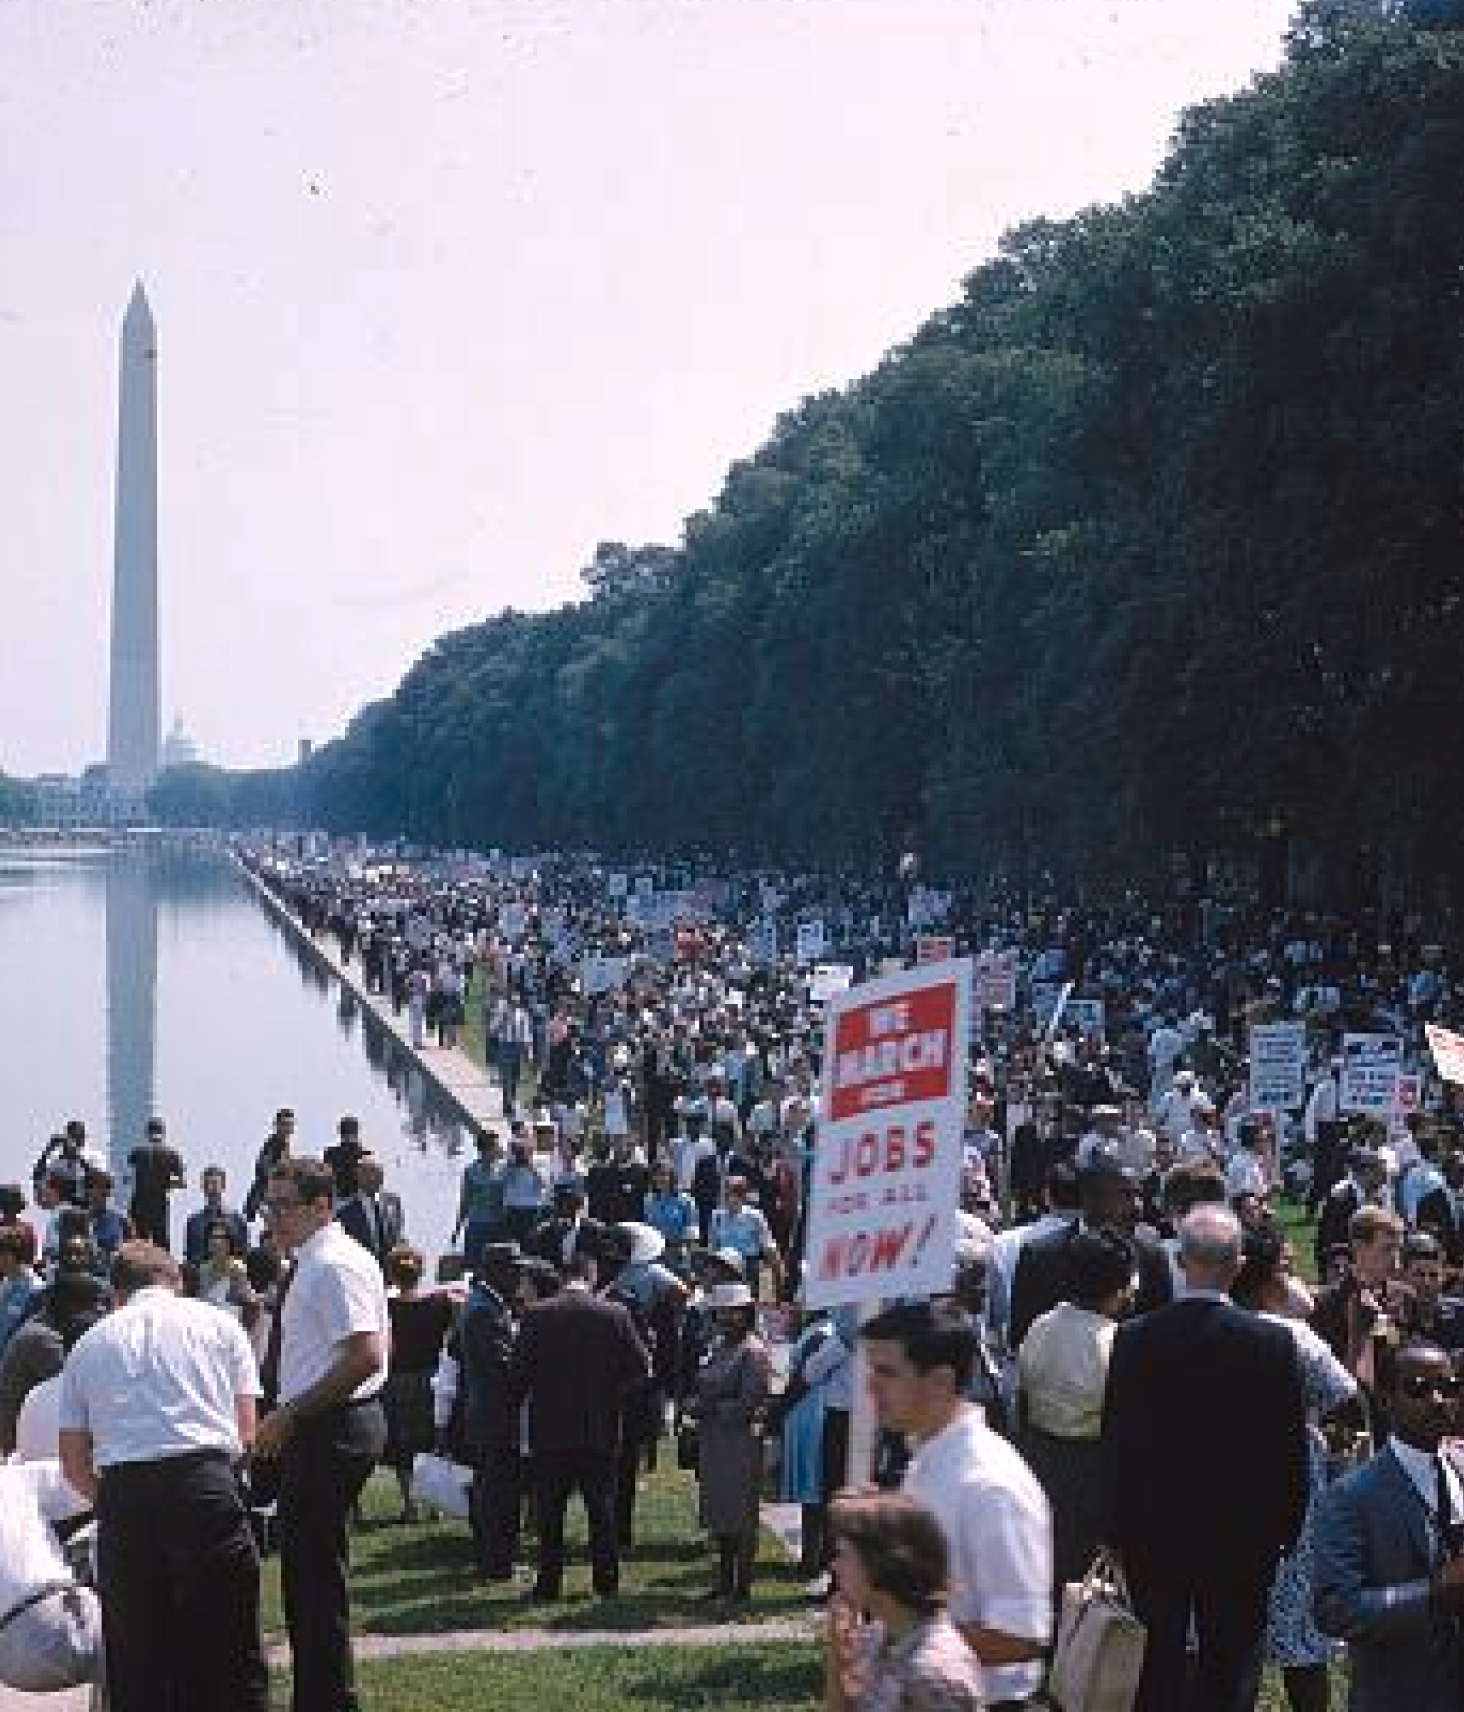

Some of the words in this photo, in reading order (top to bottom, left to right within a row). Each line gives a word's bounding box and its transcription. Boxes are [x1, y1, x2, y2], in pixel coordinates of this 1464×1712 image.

[837, 1029, 946, 1086] MARCH
[829, 1122, 936, 1184] JOBS
[819, 1214, 937, 1281] NOW!
